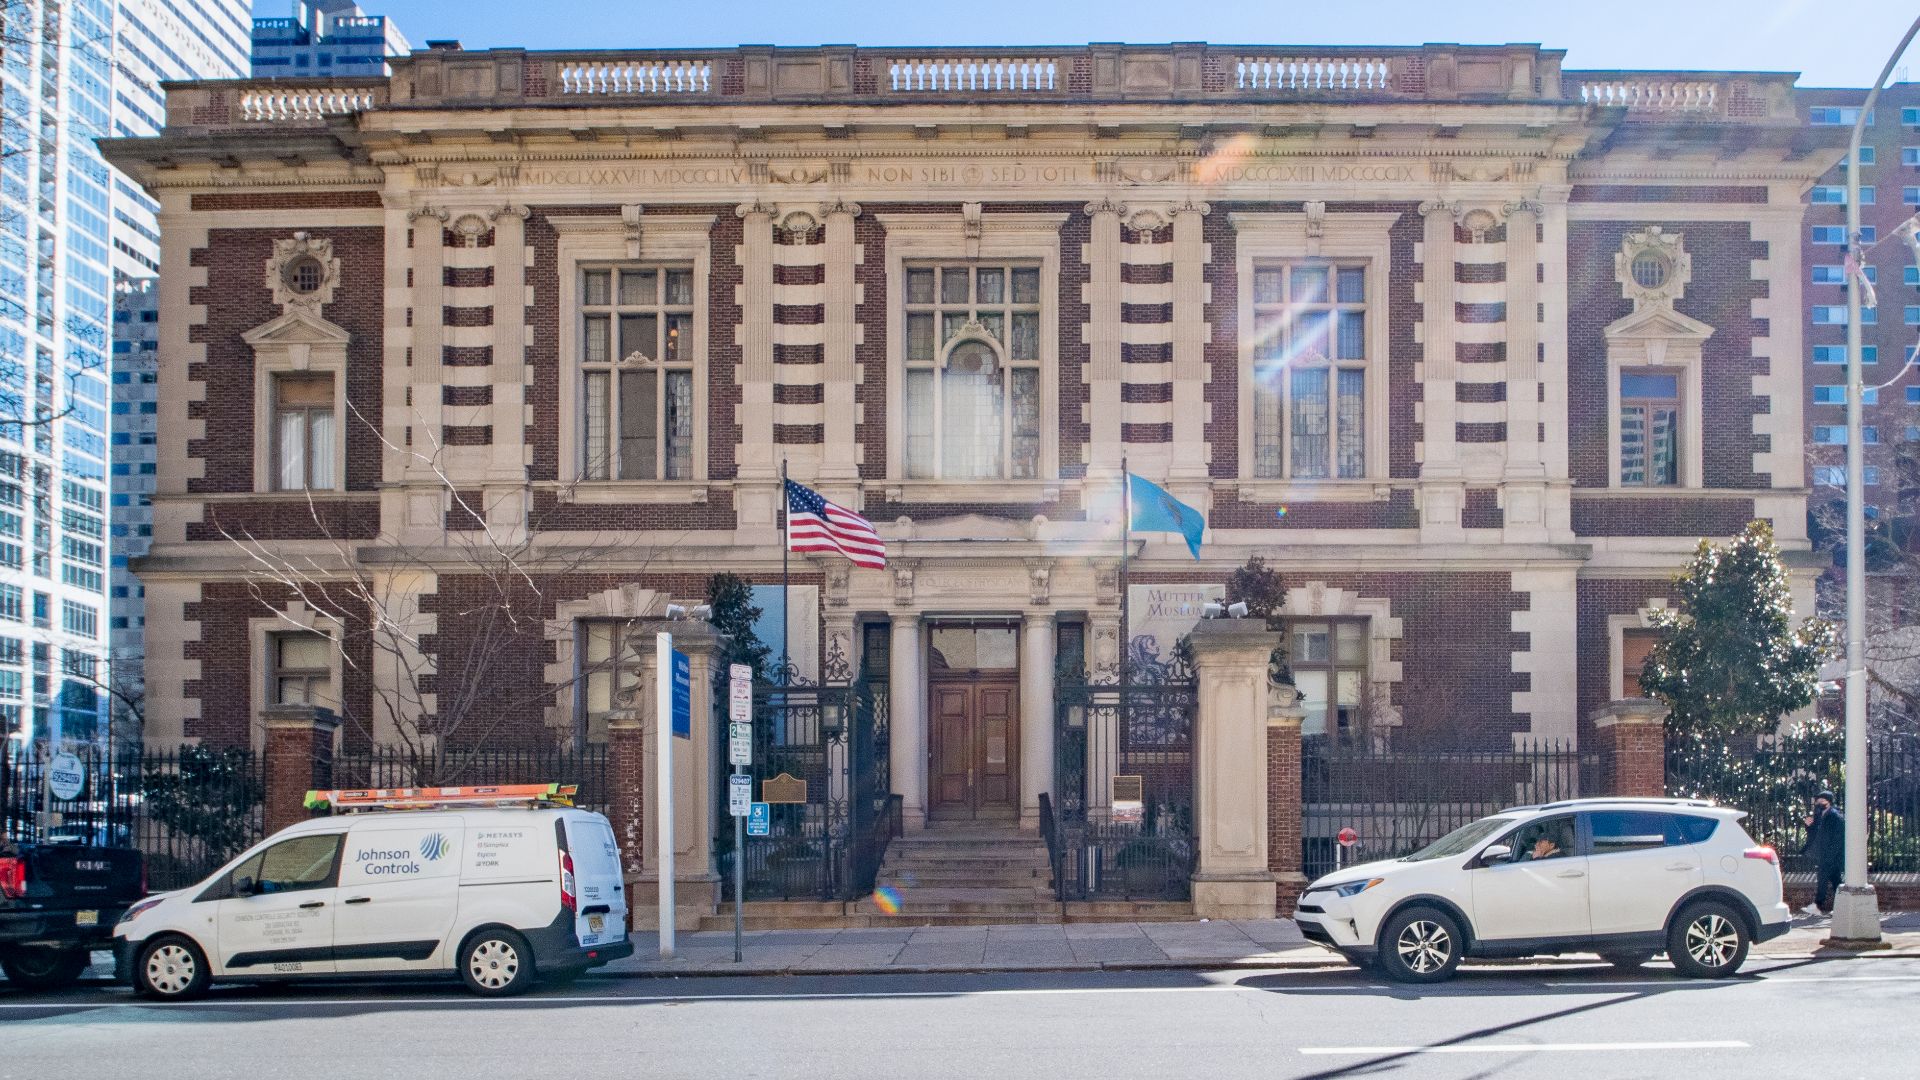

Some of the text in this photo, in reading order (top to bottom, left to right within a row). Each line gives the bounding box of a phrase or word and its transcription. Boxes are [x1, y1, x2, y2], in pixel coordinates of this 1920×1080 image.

[526, 169, 647, 184] MDCCLXXXVII
[868, 167, 956, 182] NON SIBI
[992, 167, 1076, 182] SED TOTI
[1216, 166, 1315, 182] MDCCCLXIII
[731, 725, 737, 737] 2
[356, 848, 410, 862] Johnson
[365, 861, 420, 875] Controls
